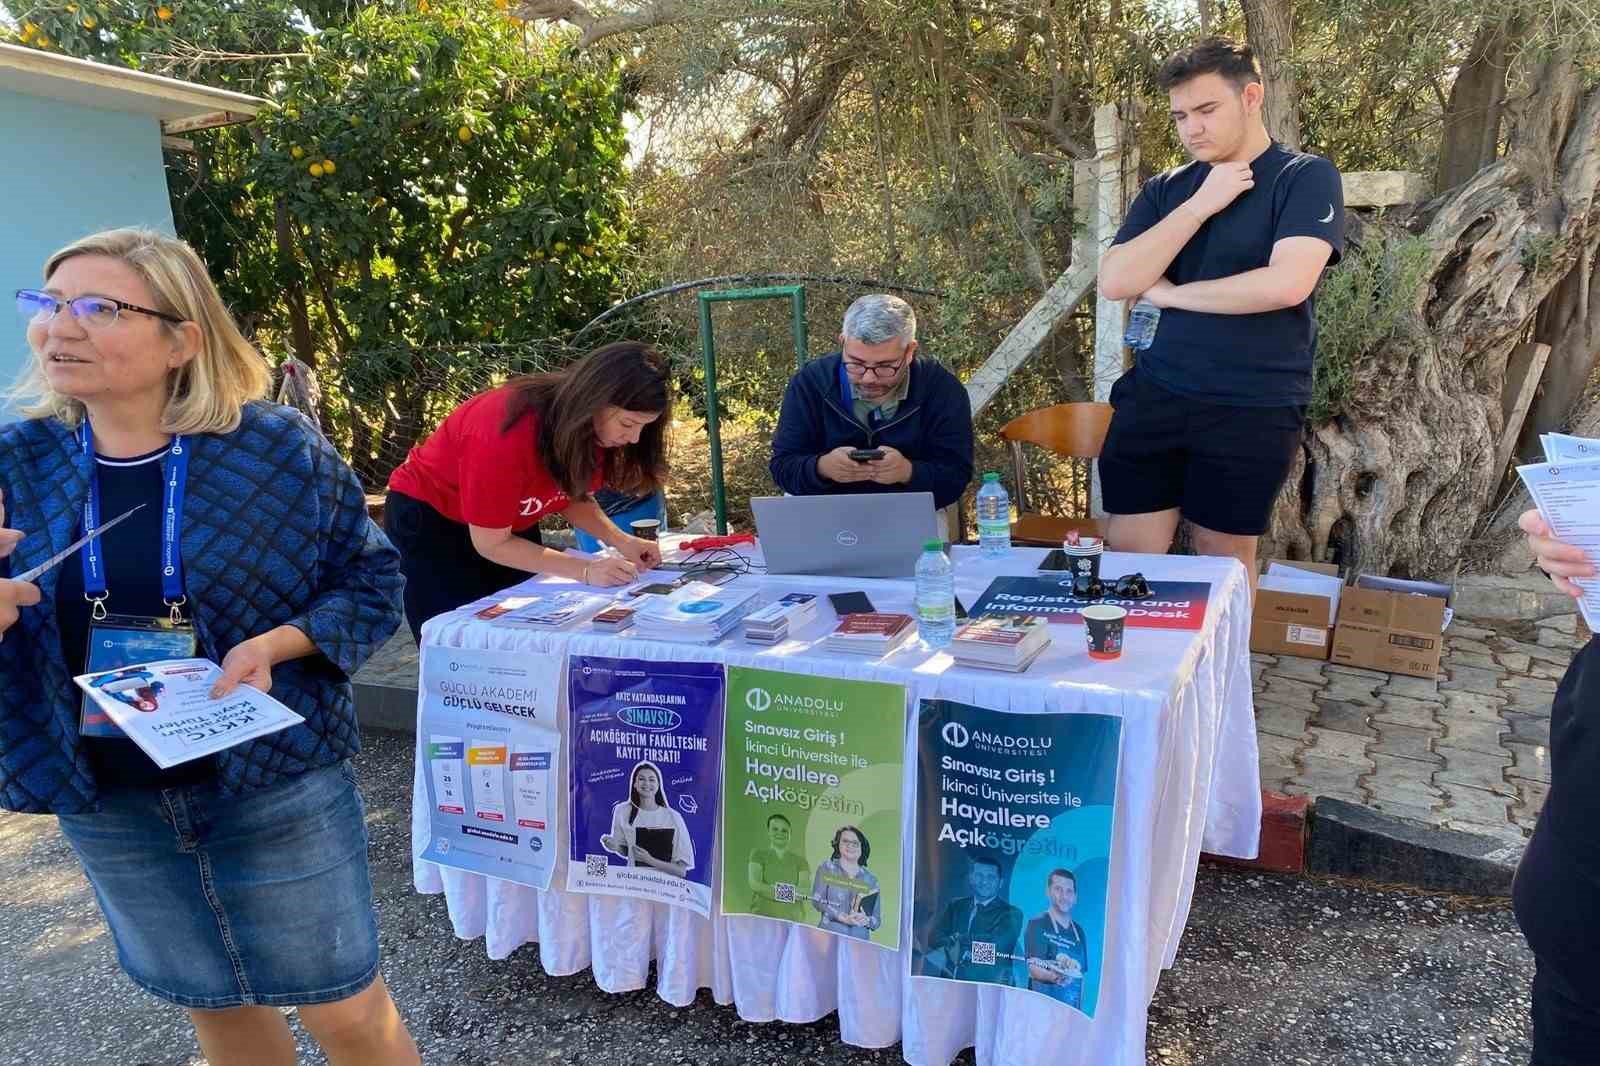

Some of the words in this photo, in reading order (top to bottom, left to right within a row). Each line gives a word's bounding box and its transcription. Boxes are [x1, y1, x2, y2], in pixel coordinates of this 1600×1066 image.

[1128, 608, 1190, 619] Desk
[1141, 598, 1191, 609] and
[443, 695, 482, 710] GÜÇLÜ
[484, 702, 536, 719] GELECEK
[774, 694, 844, 711] ANADOLU
[187, 715, 255, 741] KKTC
[626, 708, 674, 726] SINAVSIZ
[590, 728, 647, 747] AÇIKÖĞRETİM
[649, 734, 708, 752] FAKÜLTESİNE
[744, 720, 801, 740] Sınavsız
[803, 728, 837, 747] Giriş
[972, 731, 1052, 749] ANADOLU
[616, 746, 640, 760] KAYIT
[644, 749, 680, 764] FIRSATI!
[745, 736, 779, 756] İkinci
[781, 743, 848, 766] Üniversite
[851, 753, 868, 769] ile
[746, 757, 840, 786] Hayallere
[941, 755, 1001, 780] Sınavsız
[1005, 768, 1046, 786] Giriş
[744, 780, 864, 816] Açıköğretim
[942, 774, 978, 796] İkinci
[982, 783, 1060, 806] Üniversite
[1064, 792, 1082, 807] ile
[941, 797, 1050, 829] Hayallere
[938, 823, 1078, 860] Açıköğretim
